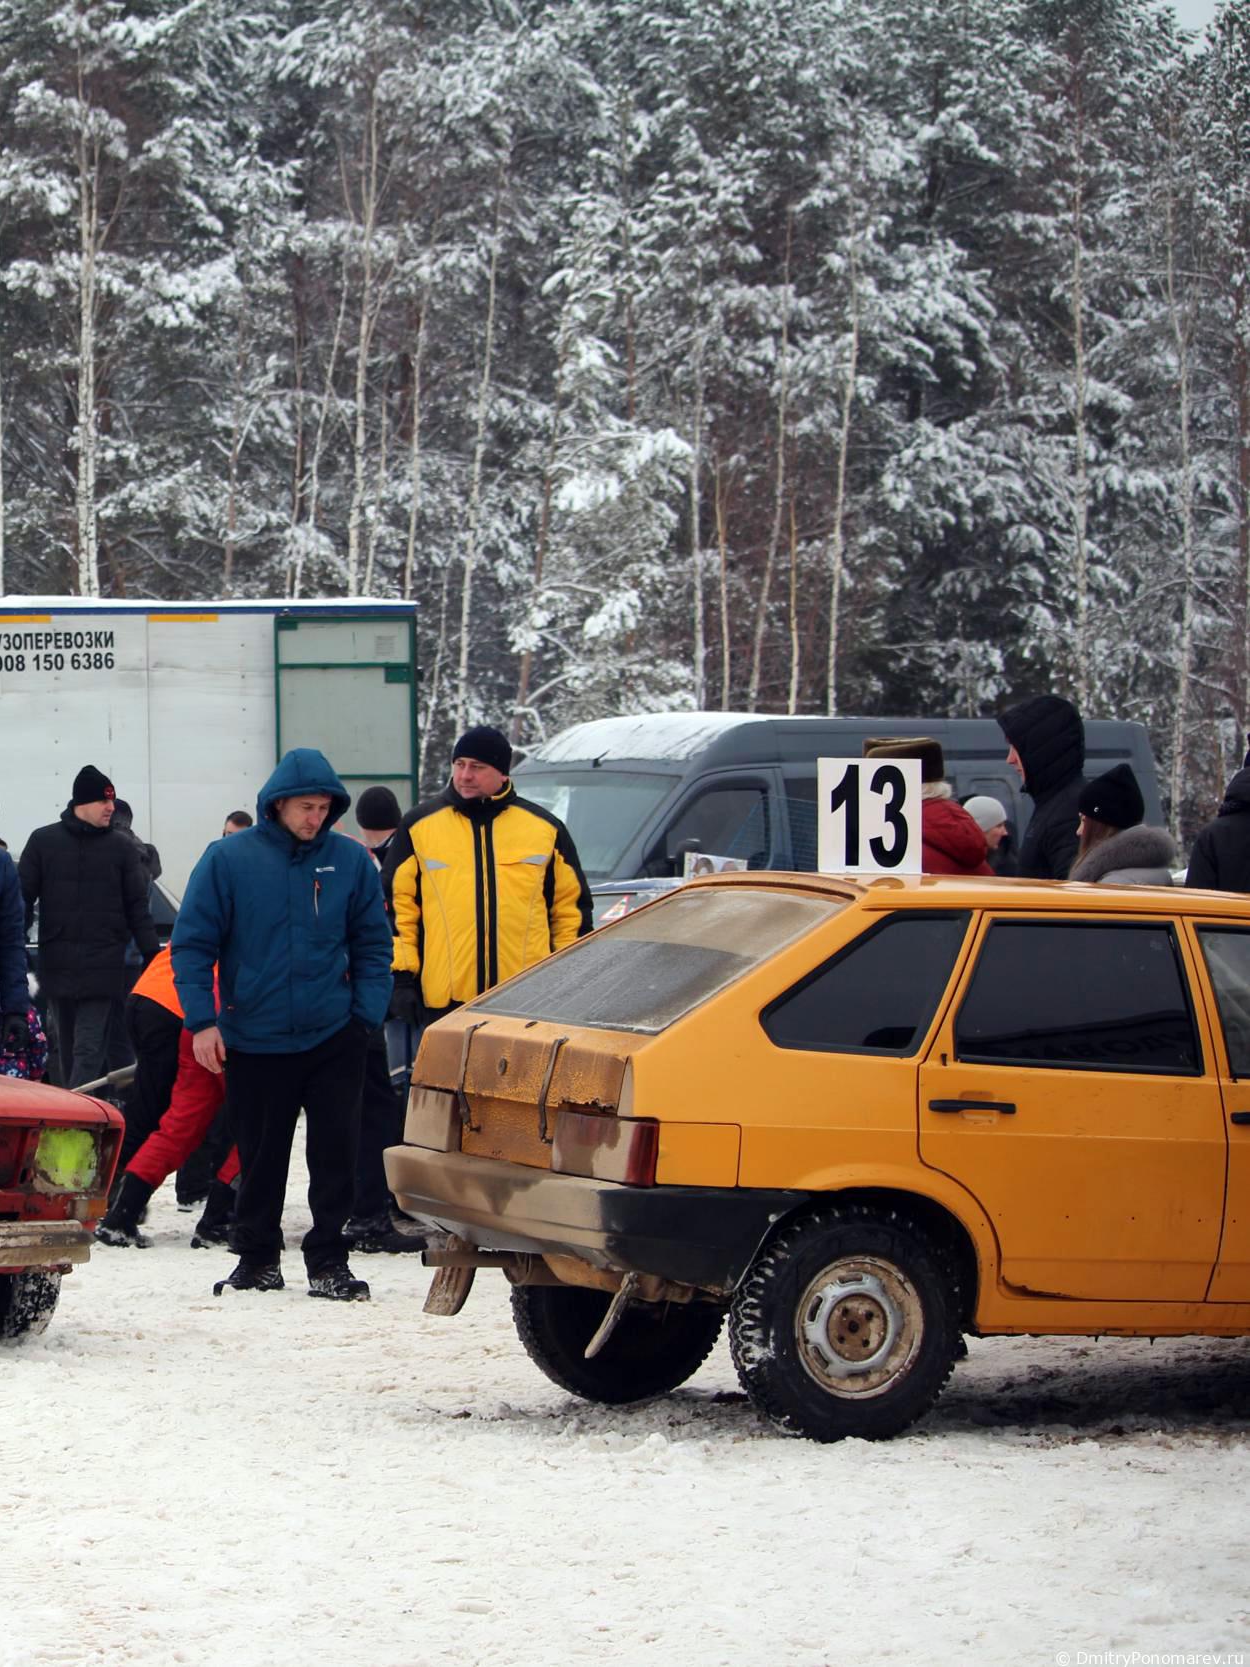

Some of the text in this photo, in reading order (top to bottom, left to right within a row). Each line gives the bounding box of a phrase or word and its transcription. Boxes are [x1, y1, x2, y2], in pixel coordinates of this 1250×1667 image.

[32, 653, 65, 671] 150
[71, 652, 115, 670] 6386
[831, 764, 909, 868] 13
